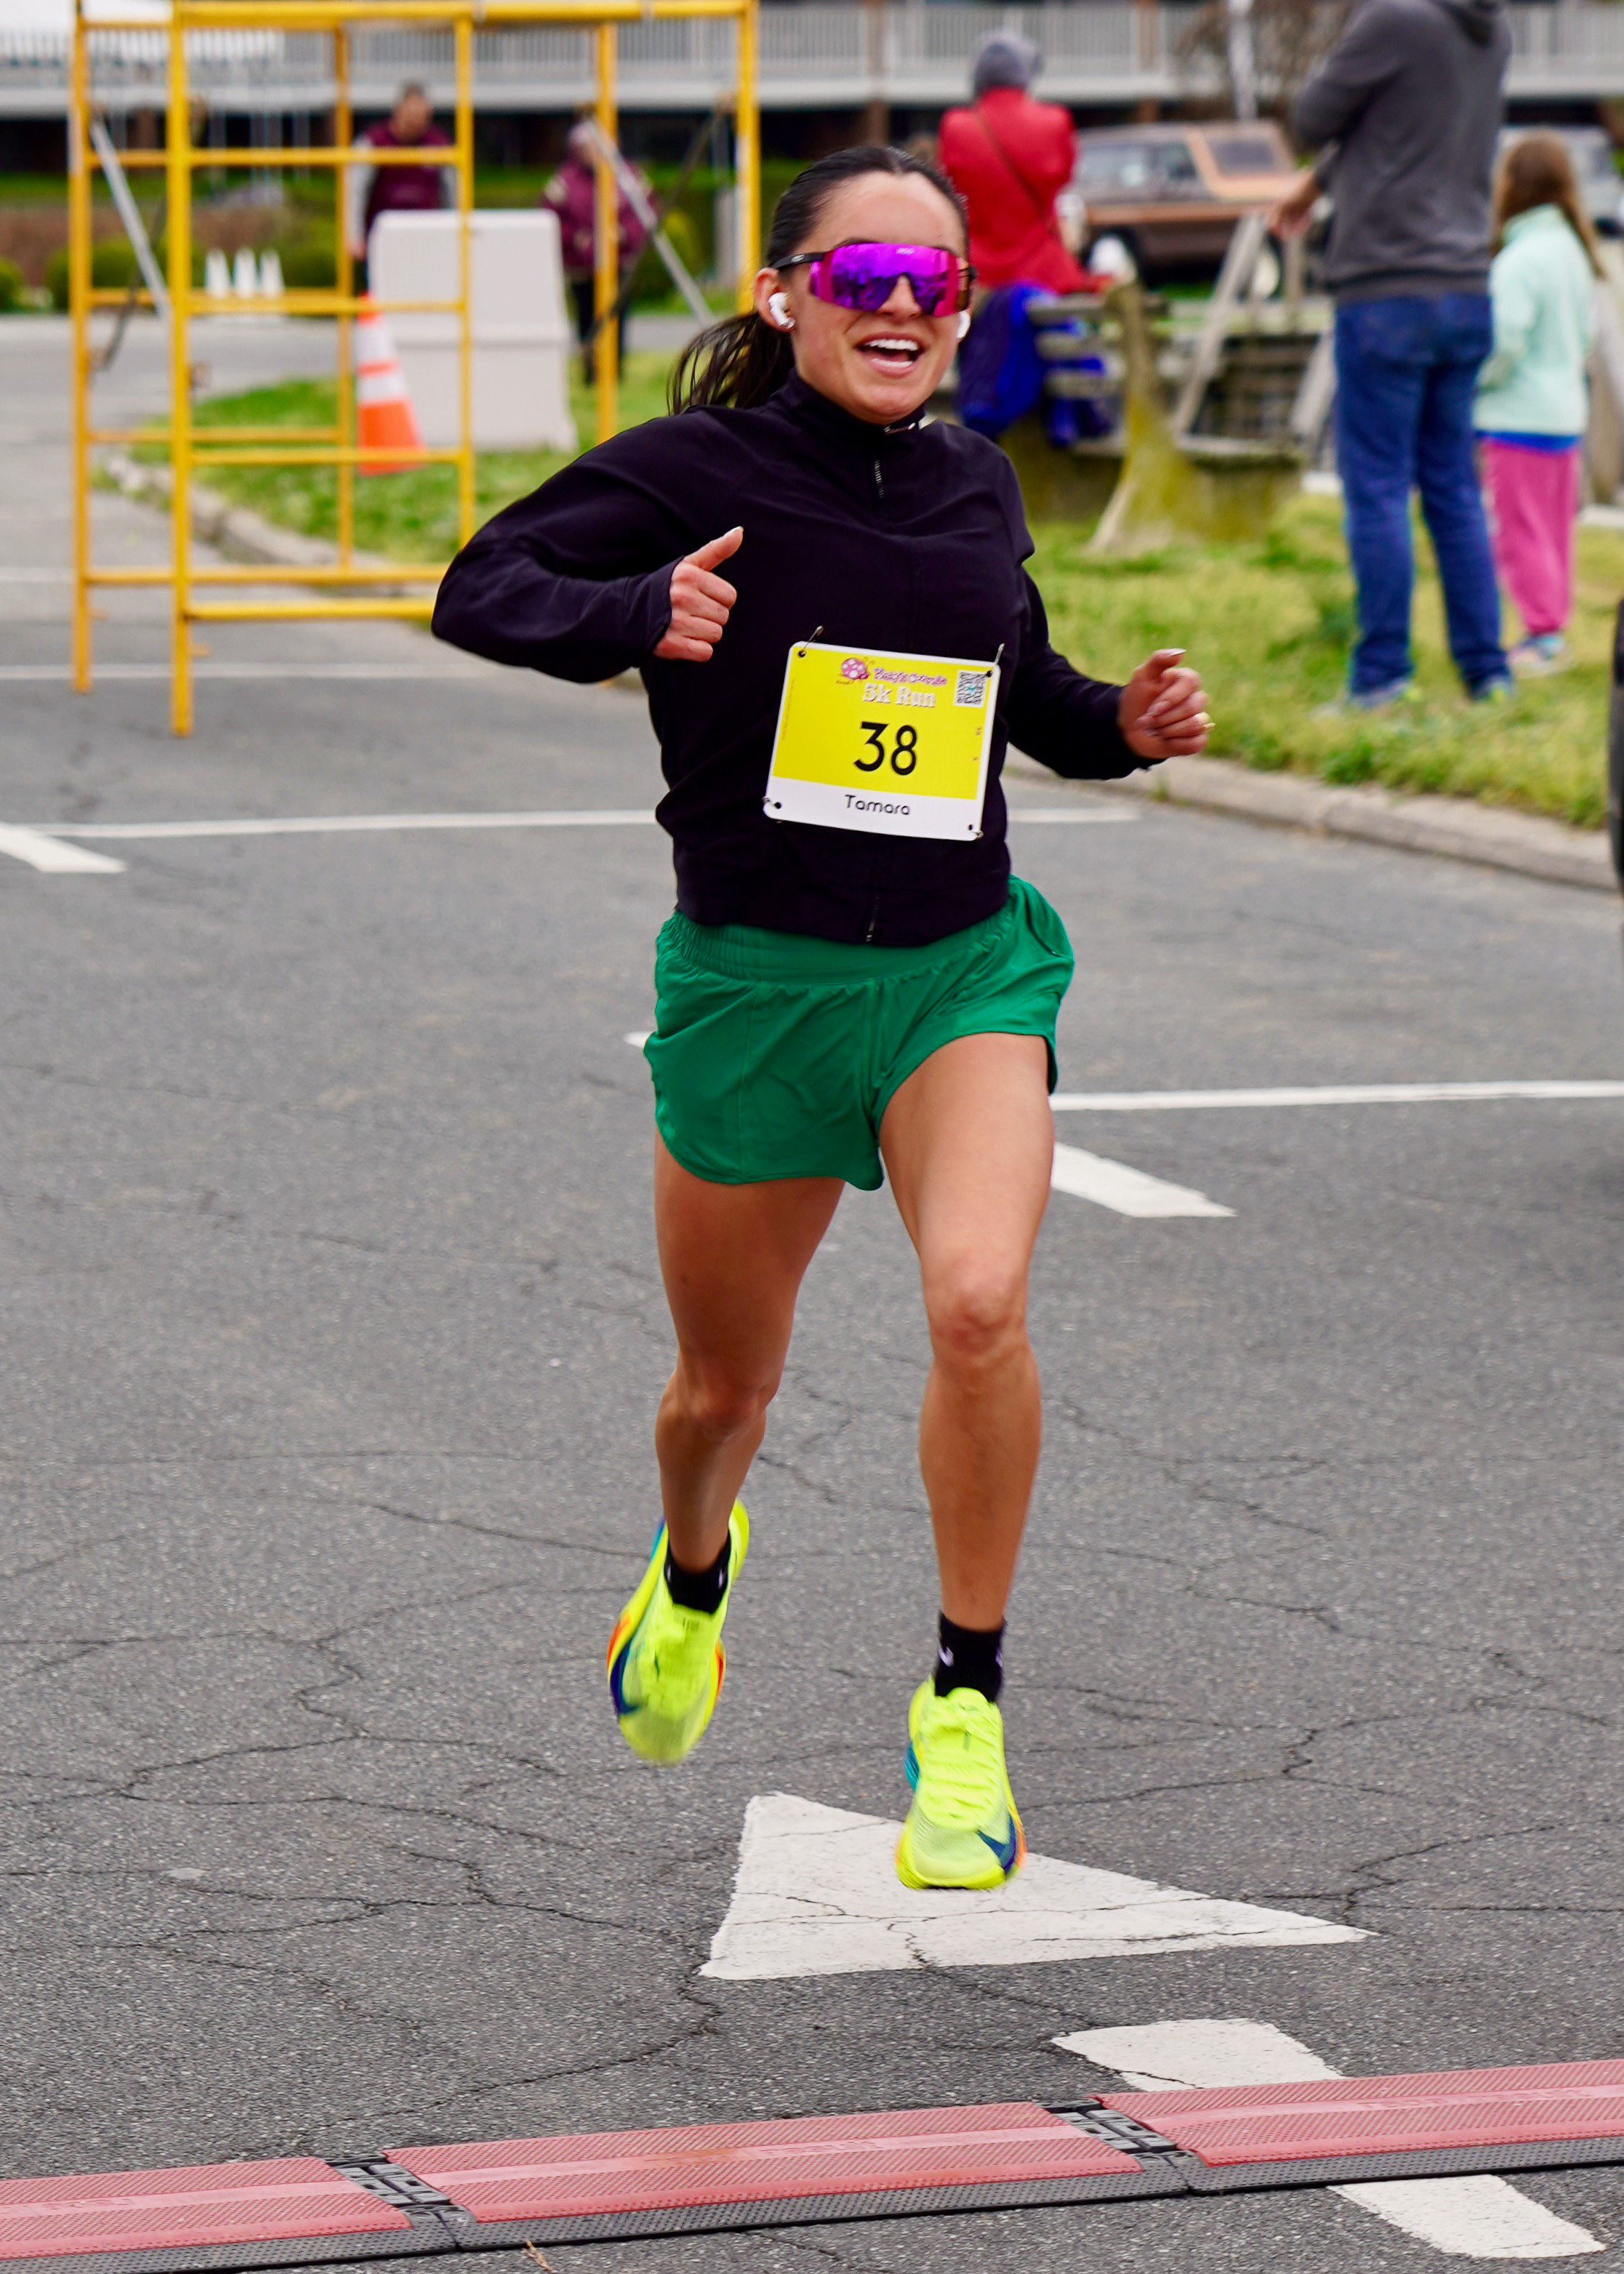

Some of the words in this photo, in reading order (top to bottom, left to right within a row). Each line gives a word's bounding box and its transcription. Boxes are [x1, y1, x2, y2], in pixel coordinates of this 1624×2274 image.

[863, 683, 891, 704] 5k
[896, 686, 936, 708] Run
[854, 721, 918, 776] 38
[845, 795, 909, 815] Tamara
